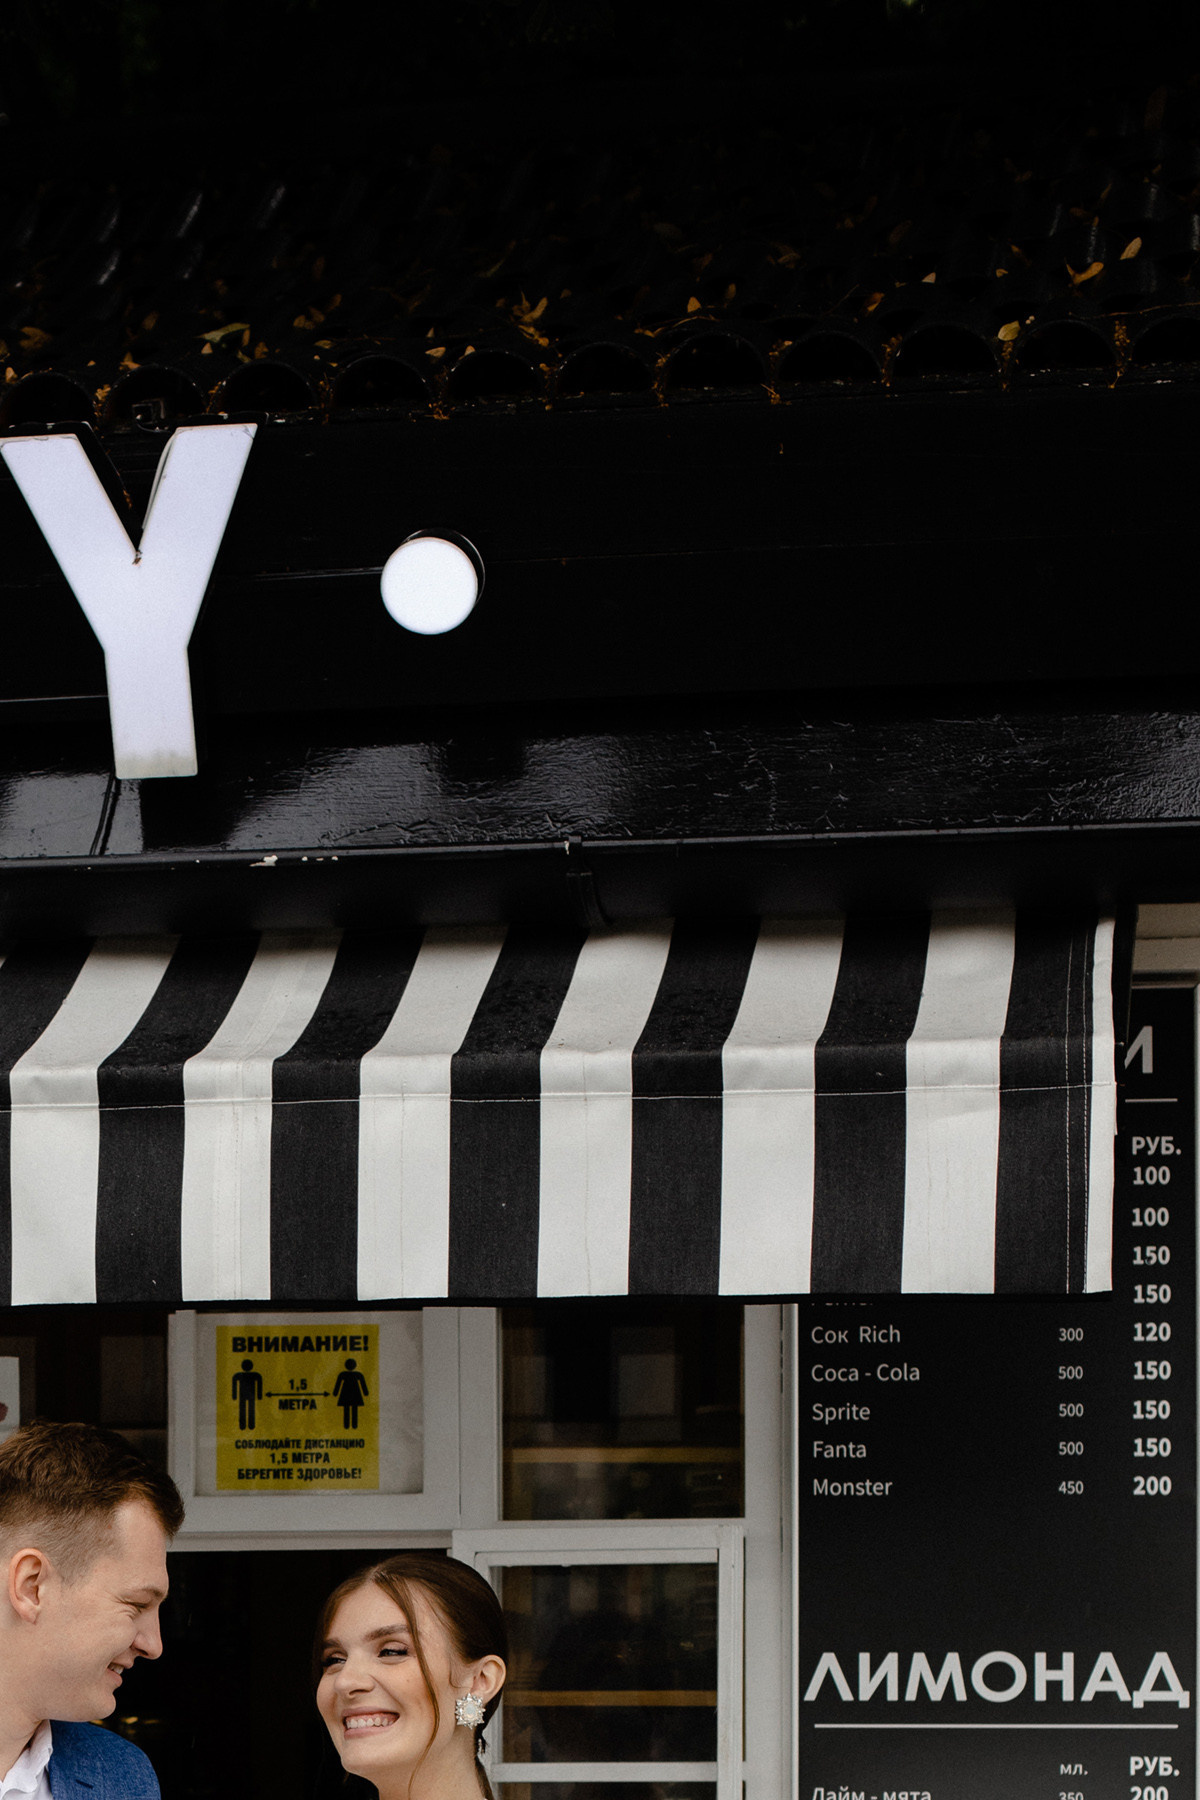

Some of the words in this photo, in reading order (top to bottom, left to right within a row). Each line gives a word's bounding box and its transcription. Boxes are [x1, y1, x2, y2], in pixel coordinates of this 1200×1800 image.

[1132, 1136, 1181, 1155] РУБ.
[1133, 1166, 1170, 1185] 100
[1132, 1207, 1169, 1226] 100
[1133, 1246, 1170, 1265] 150
[1134, 1284, 1171, 1303] 150
[860, 1325, 900, 1343] Rich
[1059, 1328, 1083, 1341] 300
[1134, 1322, 1171, 1341] 120
[232, 1335, 368, 1352] ВНИМАНИЕ!
[812, 1365, 858, 1381] Coca
[877, 1363, 919, 1381] Cola
[1059, 1366, 1083, 1379] 500
[1134, 1361, 1171, 1380] 150
[289, 1379, 307, 1392] 1,5
[279, 1399, 316, 1410] МЕТРА
[813, 1403, 870, 1424] Sprite
[1059, 1403, 1083, 1417] 500
[1133, 1400, 1170, 1419] 150
[235, 1437, 301, 1450] СОБЛЮДАЙТЕ
[304, 1439, 365, 1450] ДИСТАНЦИЮ
[814, 1441, 866, 1458] Fanta
[1059, 1442, 1083, 1455] 500
[1134, 1438, 1171, 1457] 150
[270, 1453, 288, 1465] 1,5
[292, 1452, 330, 1464] МЕТРА
[238, 1468, 293, 1480] БЕРЕГИТЕ
[297, 1468, 361, 1481] ЗДОРОВЬЕ!
[814, 1479, 892, 1496] Monster
[1059, 1481, 1083, 1494] 450
[1134, 1476, 1171, 1495] 200
[804, 1651, 1190, 1708] ЛИМОНАД
[1060, 1764, 1088, 1775] мл.
[1130, 1756, 1179, 1776] РУБ.
